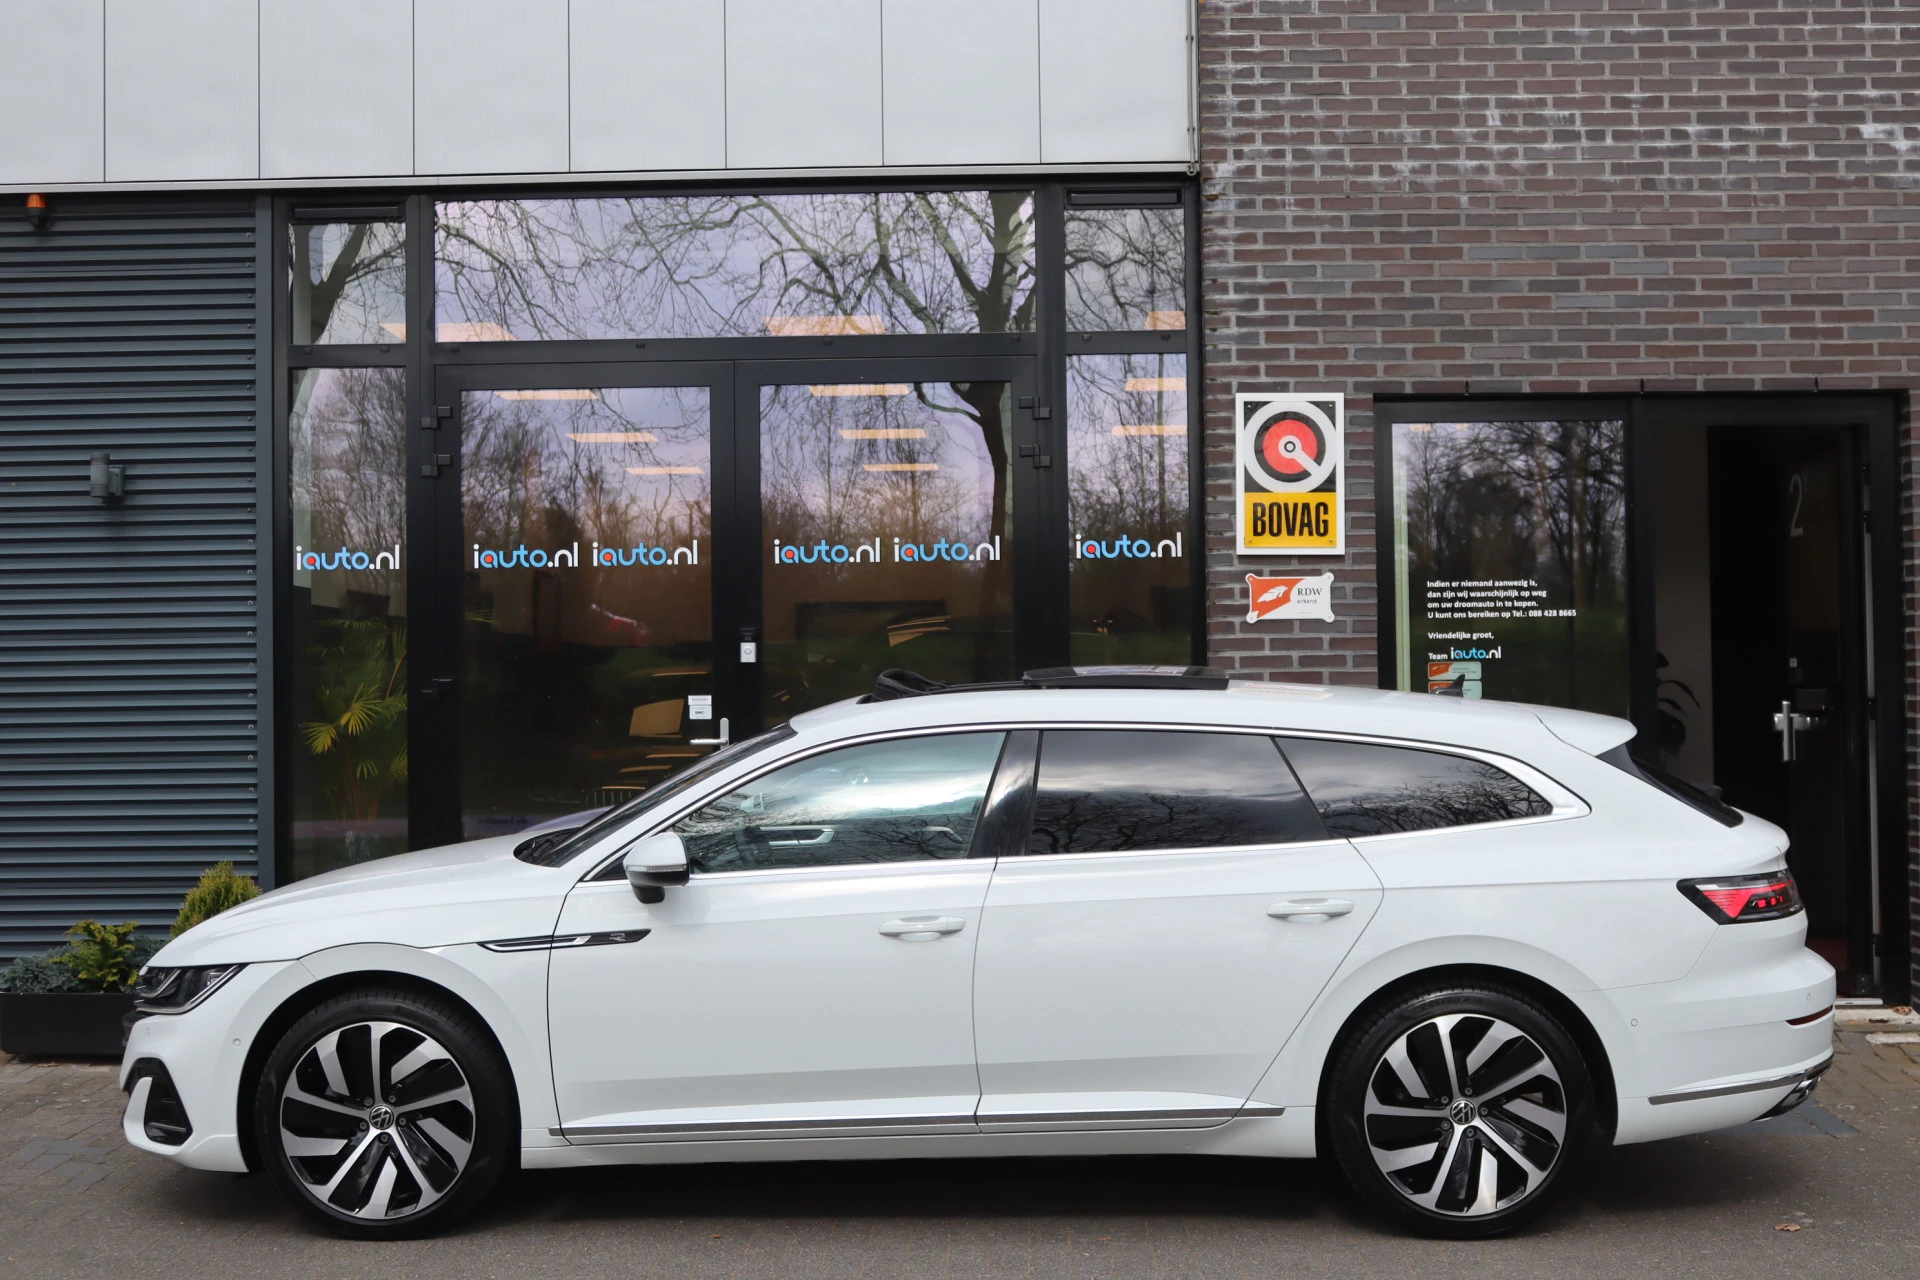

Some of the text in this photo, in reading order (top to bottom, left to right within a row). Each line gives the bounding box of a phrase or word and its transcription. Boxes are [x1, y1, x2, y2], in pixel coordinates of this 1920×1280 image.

[1252, 502, 1329, 538] BOVAG
[774, 535, 1000, 564] iauto.nl iauto.nl
[1076, 532, 1182, 559] iauto.nl
[296, 544, 400, 570] iauto.nl
[473, 540, 698, 569] iauto.nl iauto.nl
[1494, 579, 1528, 588] aanwezig
[1529, 579, 1538, 587] is,
[1297, 588, 1322, 596] RDW
[1427, 590, 1441, 598] dan
[1443, 590, 1455, 599] zijn
[1457, 590, 1468, 599] wij
[1469, 589, 1519, 598] waarschijnlijk
[1520, 590, 1530, 598] op
[1513, 600, 1539, 608] kopen.
[1468, 610, 1499, 618] bereiken
[1501, 611, 1511, 619] op
[1528, 609, 1542, 617] 088
[1543, 609, 1557, 617] 428
[1558, 609, 1577, 617] 8665
[1428, 631, 1494, 640] Vriendelijke groet,
[1428, 646, 1502, 660] Team iauto.nl
